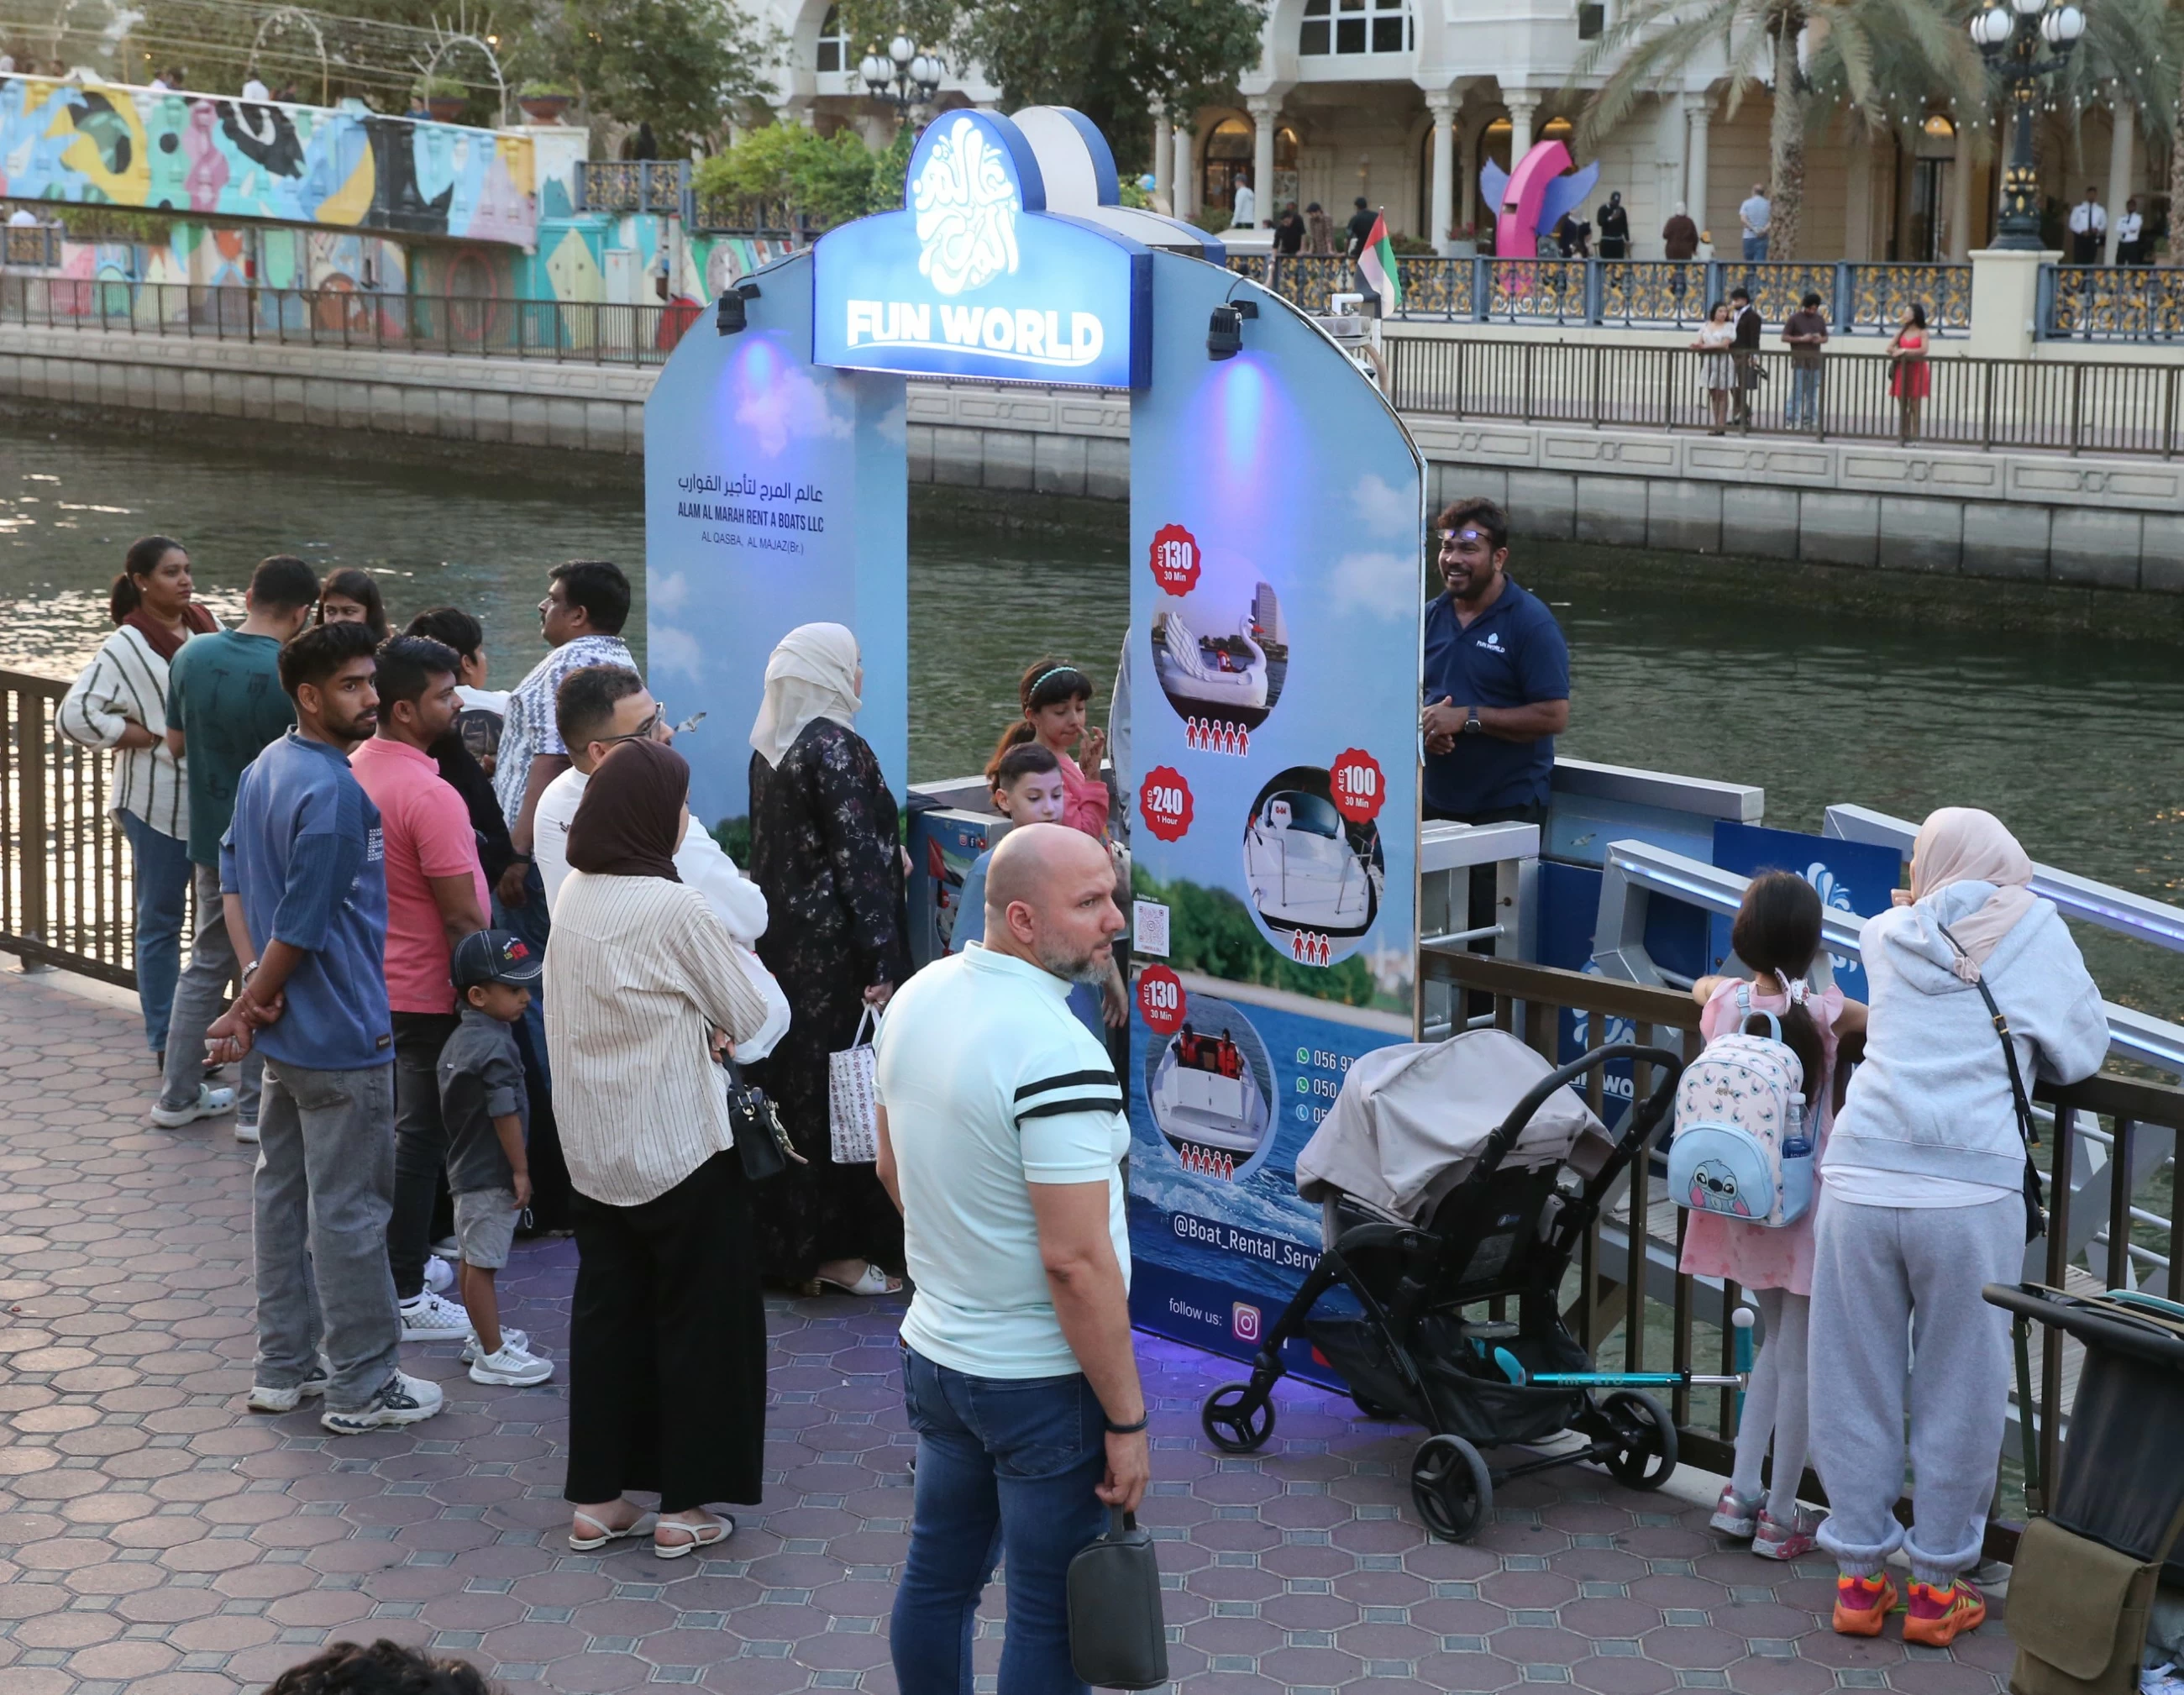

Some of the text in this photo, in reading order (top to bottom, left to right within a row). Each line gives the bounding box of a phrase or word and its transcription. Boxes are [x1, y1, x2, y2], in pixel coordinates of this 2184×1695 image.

[847, 299, 1105, 362] FUN WORLD
[678, 473, 823, 504] عالم المرح لتأجير القوارب
[678, 501, 824, 533] ALAM AL MARAH RENT A BOATS LLC
[701, 531, 711, 543] AL
[747, 536, 758, 548] AL
[1163, 540, 1193, 570] 130
[1163, 570, 1186, 582] 30 Min
[1344, 764, 1376, 797] 100
[1152, 785, 1183, 816] 240
[1345, 795, 1369, 809] 30 Min
[1162, 816, 1179, 825] Hour
[1148, 979, 1178, 1010] 130
[1150, 1009, 1173, 1021] 30 Min
[1314, 1050, 1336, 1070] 056
[1313, 1078, 1337, 1099] 050
[1168, 1298, 1223, 1326] follow us:
